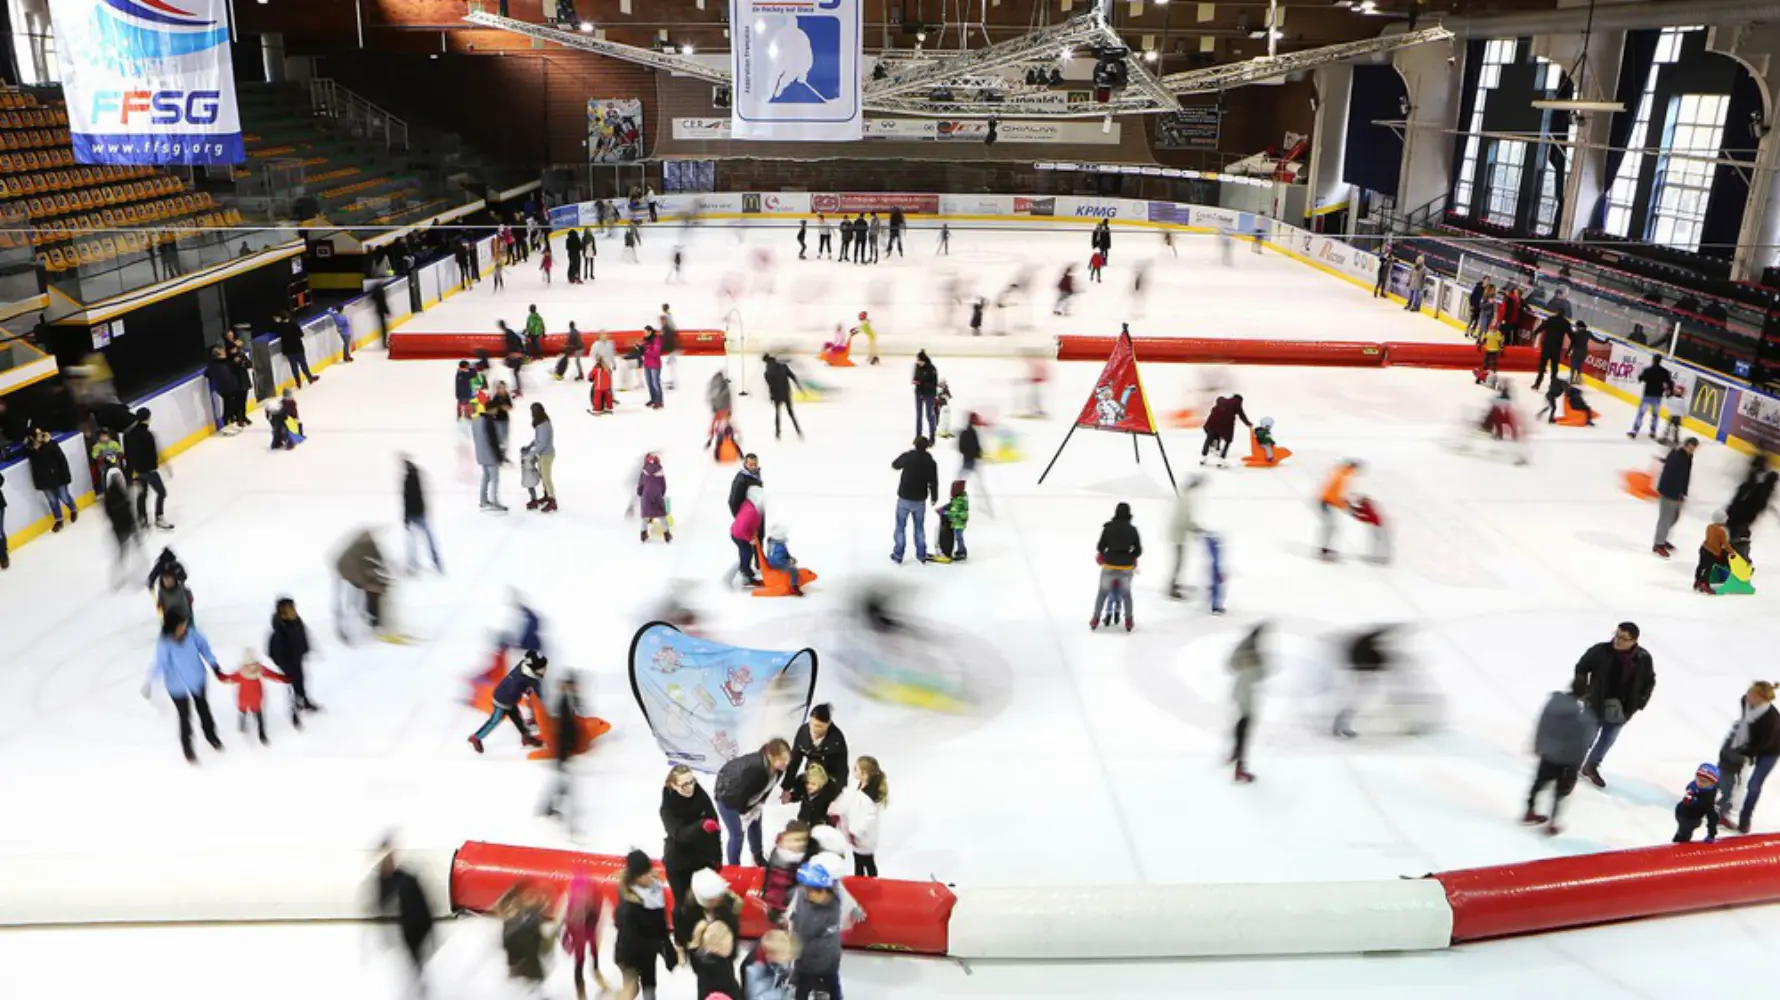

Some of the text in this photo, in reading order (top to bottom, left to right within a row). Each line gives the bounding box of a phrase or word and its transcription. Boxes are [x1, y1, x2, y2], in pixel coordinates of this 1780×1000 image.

[91, 90, 220, 125] FFSG
[92, 143, 224, 155] www.ffsg.org
[1075, 205, 1117, 218] KPMG
[1607, 361, 1634, 378] FLOR
